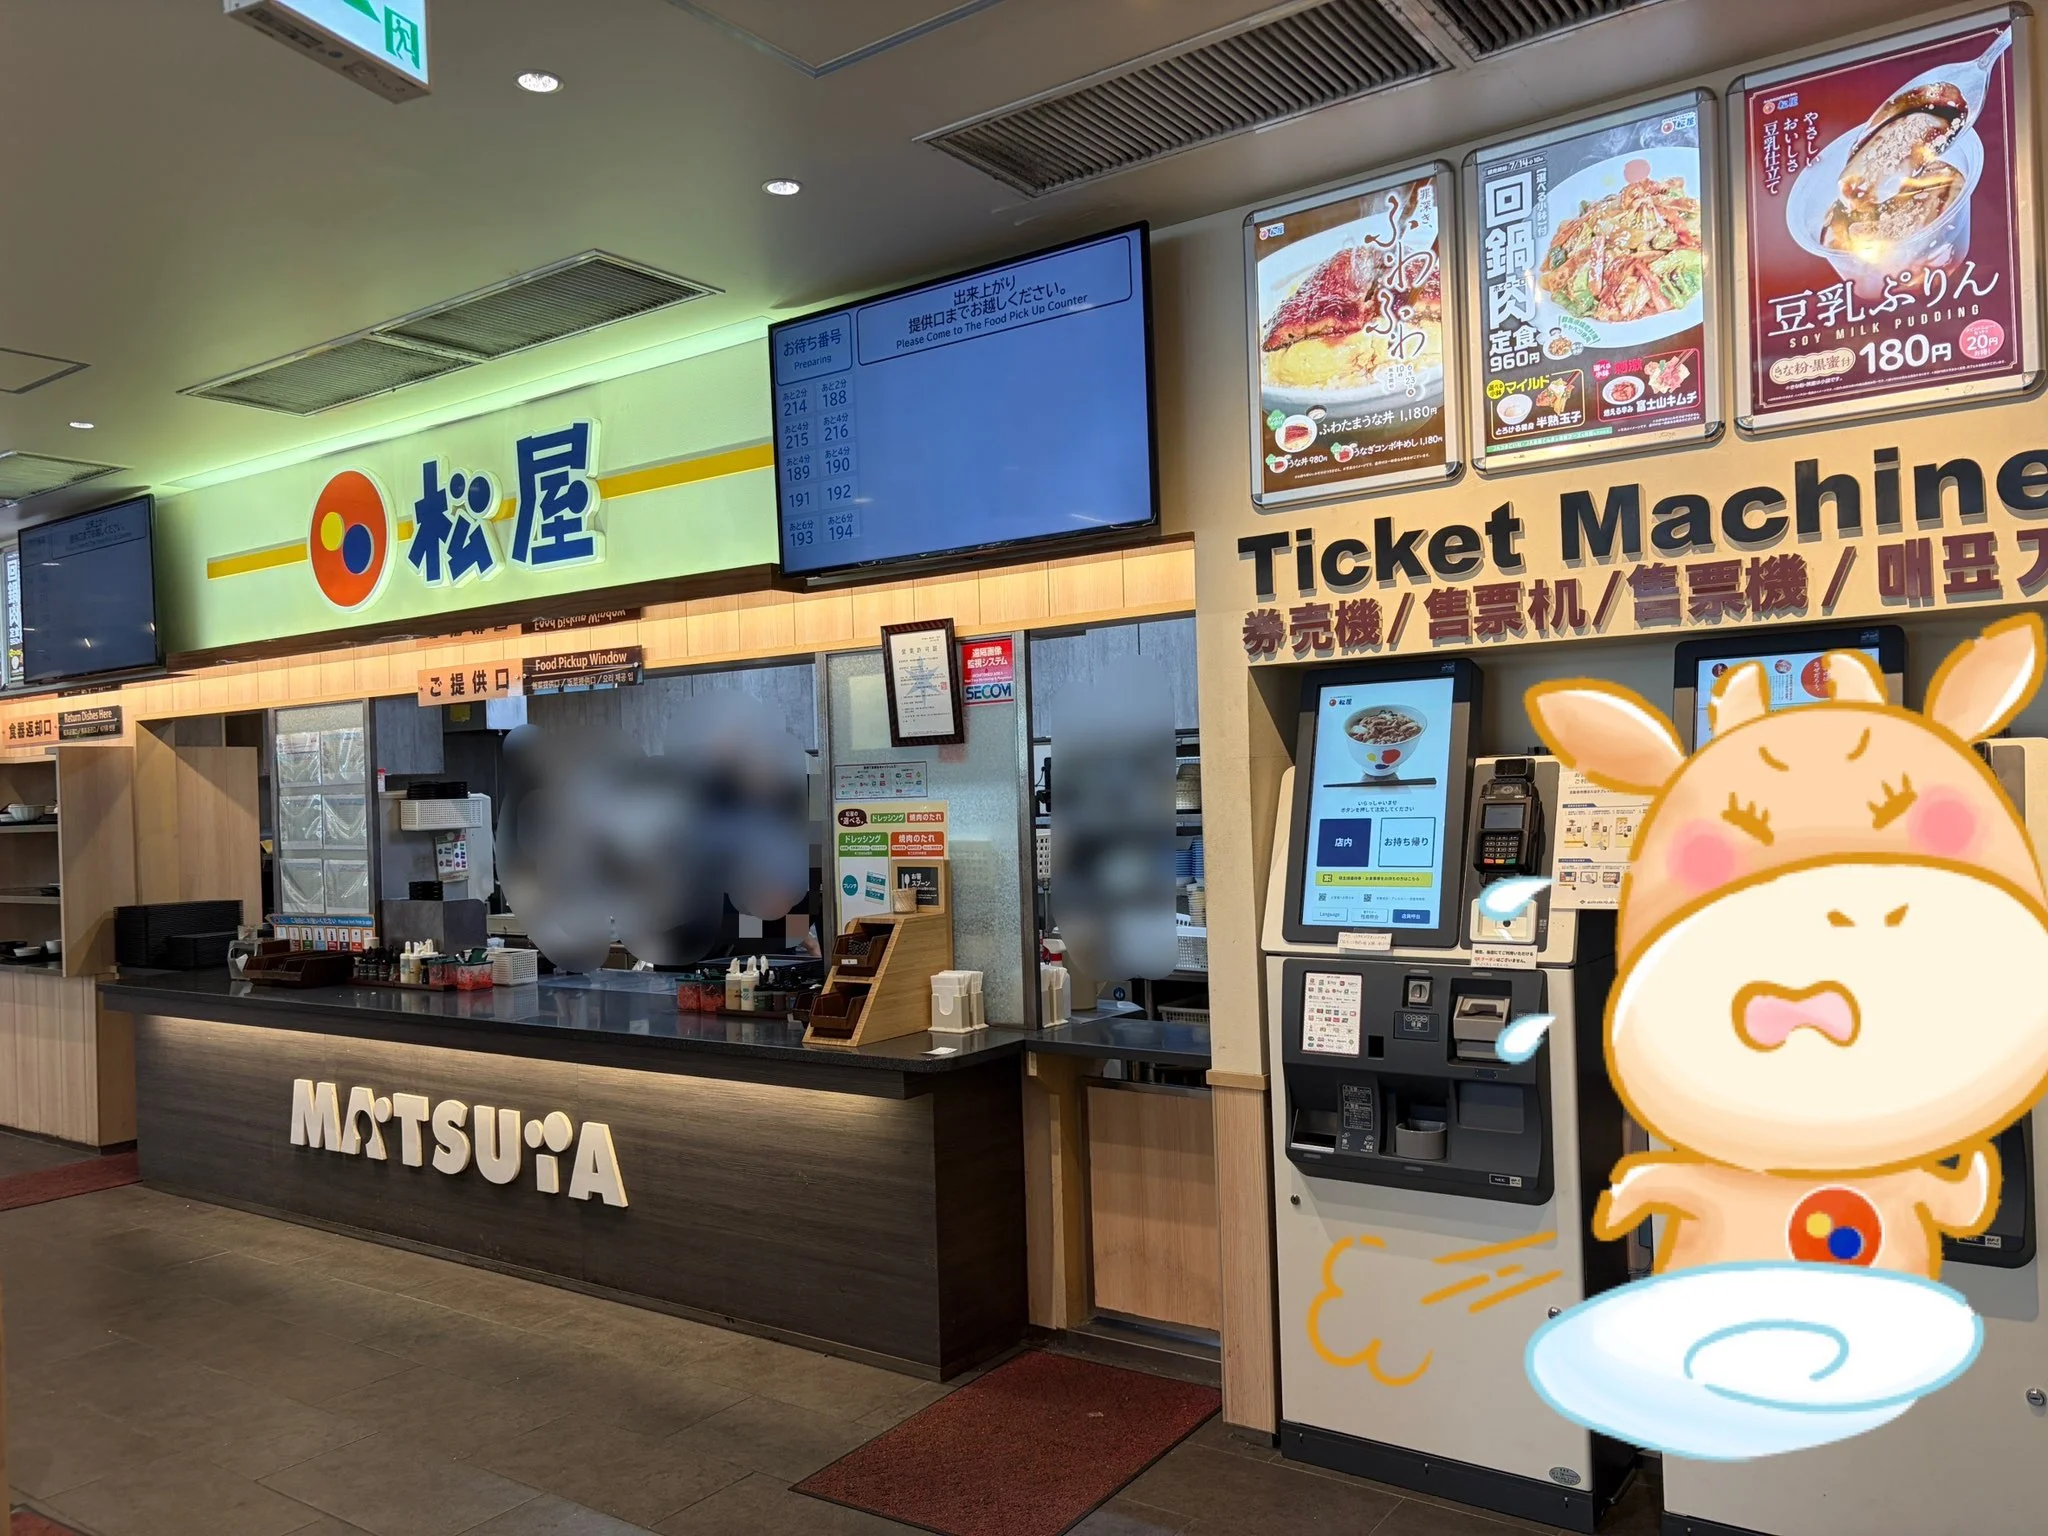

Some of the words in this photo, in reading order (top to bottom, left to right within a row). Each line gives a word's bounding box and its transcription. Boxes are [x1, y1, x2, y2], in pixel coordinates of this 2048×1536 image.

[1784, 118, 1799, 173] おいしさ
[1803, 112, 1820, 167] やさしい
[1763, 120, 1781, 194] 豆乳仕立て
[1485, 171, 1536, 330] 回鍋肉
[1364, 194, 1433, 360] ふわふわ
[953, 275, 1016, 307] 出来上がり
[1768, 261, 1999, 337] 豆乳ぷりん
[908, 282, 1066, 334] 提供口までお越しください。
[896, 335, 924, 350] Please
[926, 330, 951, 343] Come
[953, 326, 963, 336] to
[965, 321, 982, 333] The
[984, 314, 1007, 328] Food
[1009, 308, 1029, 322] Pick
[1032, 303, 1045, 316] Up
[1047, 294, 1089, 312] Counter
[1789, 332, 1822, 349] SOY
[1836, 322, 1880, 341] MILK
[1895, 304, 1980, 330] PUDDING
[783, 328, 842, 357] お待ち番号
[1489, 324, 1538, 356] 定食
[1967, 334, 1998, 351] 20円
[793, 354, 832, 371] Preparing
[1490, 350, 1540, 373] 960円
[1859, 333, 1951, 374] 180円
[1505, 375, 1550, 393] マイルド
[784, 399, 808, 417] 214
[822, 390, 847, 408] 188
[1636, 391, 1698, 413] 富士山キムチ
[1319, 410, 1395, 436] ふわたまうな丼
[1400, 405, 1437, 423] 1,180円
[1536, 411, 1582, 429] 半熟玉子
[785, 432, 809, 450] 215
[824, 424, 849, 442] 216
[786, 465, 810, 482] 189
[825, 457, 850, 475] 190
[788, 491, 811, 508] 191
[826, 484, 852, 501] 192
[408, 422, 594, 582] 松屋
[1237, 501, 1522, 597] Ticket
[1560, 446, 2048, 562] Machine
[789, 529, 814, 547] 193
[828, 523, 854, 541] 194
[535, 657, 557, 672] Food
[558, 655, 588, 670] Pickup
[589, 651, 627, 667] Window
[967, 656, 1008, 669] 監視システム
[430, 668, 510, 697] ご提供口
[966, 682, 1012, 700] SECOM
[64, 713, 82, 723] Return
[82, 710, 98, 722] Dishes
[99, 709, 112, 720] Here
[9, 719, 51, 739] 食器返却口
[909, 813, 942, 821] 焼肉のたれ
[845, 834, 881, 843] ドレッシング
[898, 834, 935, 843] 焼肉のたれ
[1334, 837, 1353, 848] 店内
[1384, 837, 1429, 847] お持ち帰り
[1319, 910, 1341, 919] Language
